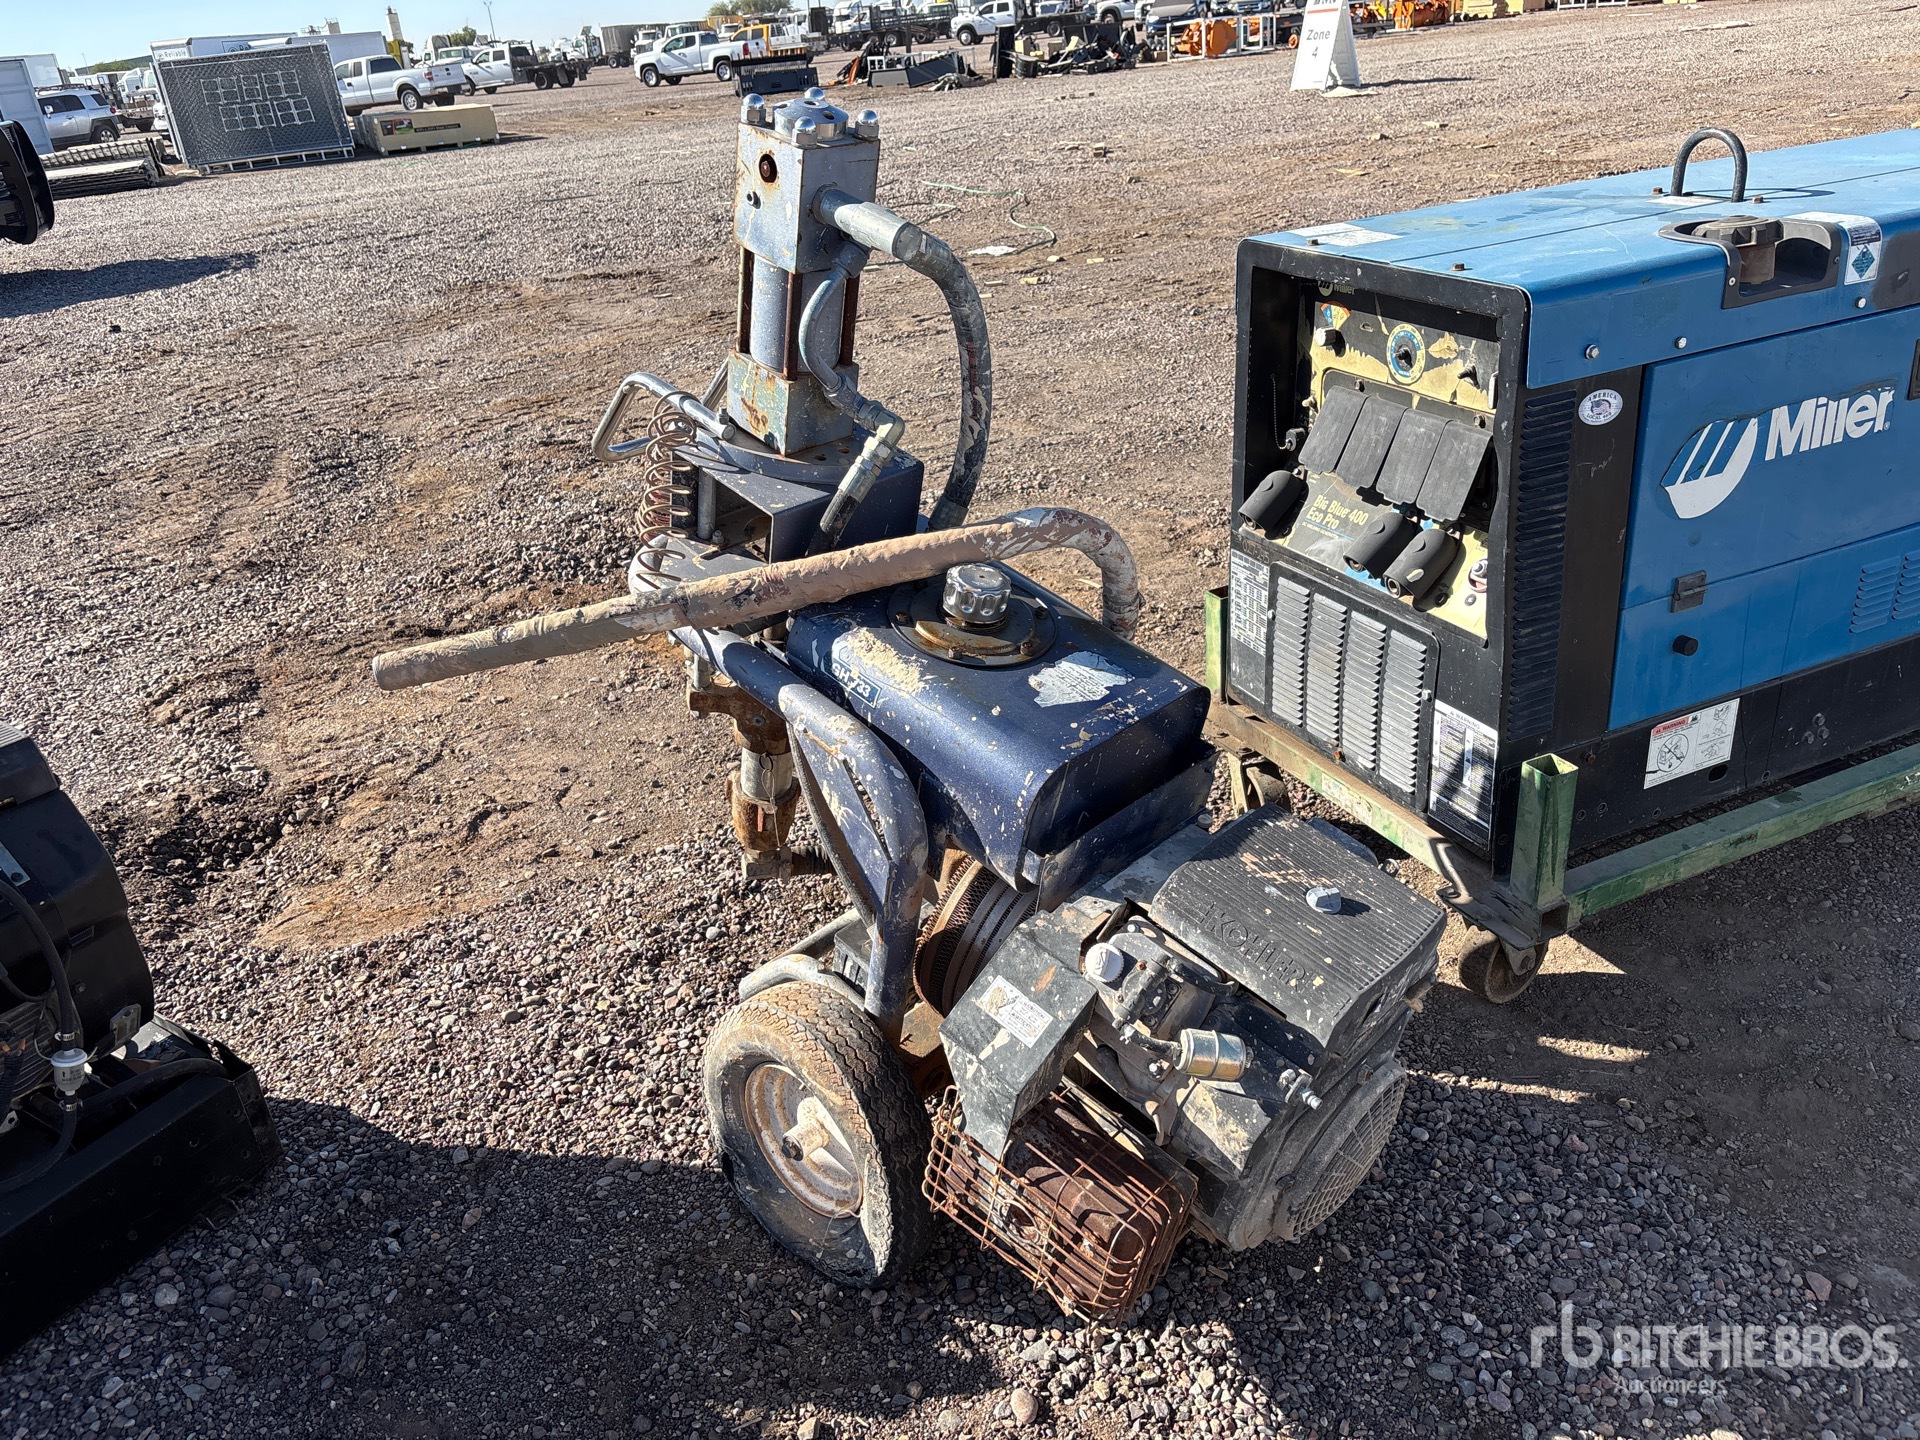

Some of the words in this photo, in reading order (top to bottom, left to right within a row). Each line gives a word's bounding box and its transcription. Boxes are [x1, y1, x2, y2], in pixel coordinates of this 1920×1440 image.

[1306, 29, 1331, 40] Zone
[164, 50, 187, 58] Reliable
[1312, 46, 1319, 58] 4
[1587, 392, 1618, 402] AMERICA
[1765, 389, 1895, 461] Miller
[1306, 506, 1324, 523] Eco
[1322, 513, 1340, 530] Pro
[1327, 500, 1348, 518] Blue
[1348, 509, 1369, 526] 400
[1662, 719, 1686, 731] WARNING
[1203, 908, 1307, 993] KOHLER
